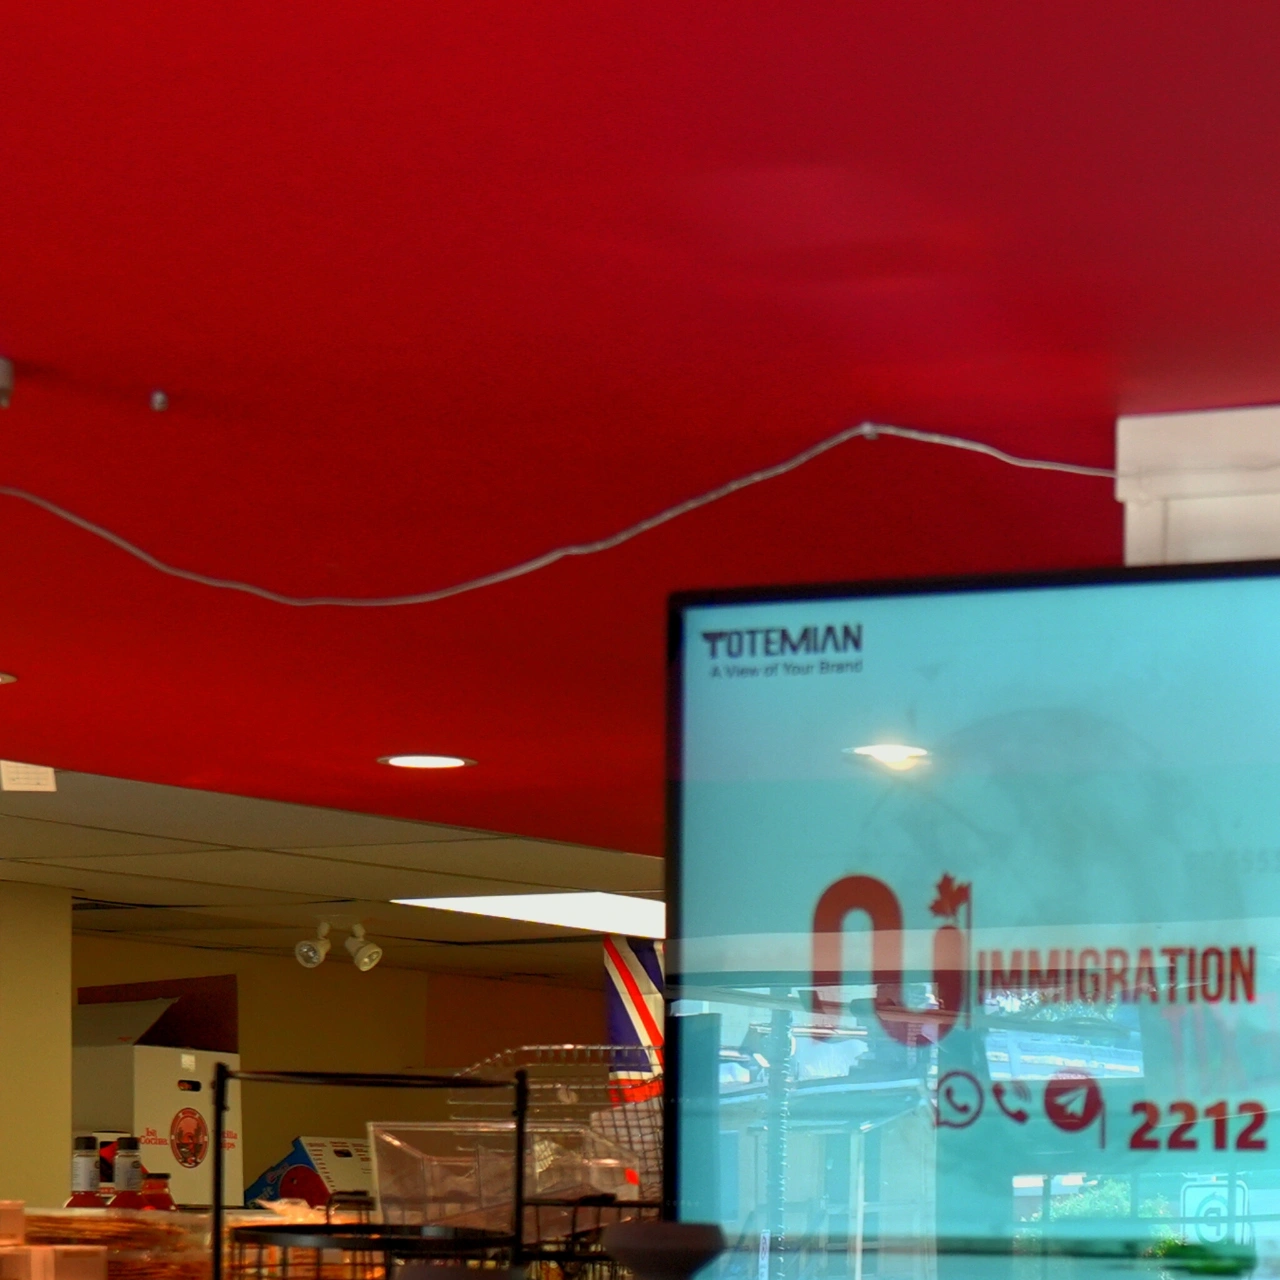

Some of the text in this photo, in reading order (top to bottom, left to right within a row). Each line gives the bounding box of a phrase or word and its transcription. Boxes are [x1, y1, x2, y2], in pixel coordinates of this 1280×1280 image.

[702, 624, 863, 660] TOTEMIAN
[725, 665, 759, 678] View
[783, 662, 814, 676] Your
[820, 660, 863, 674] Brand
[978, 946, 1257, 1005] IMMIGRATION
[1129, 1101, 1269, 1150] 2212
